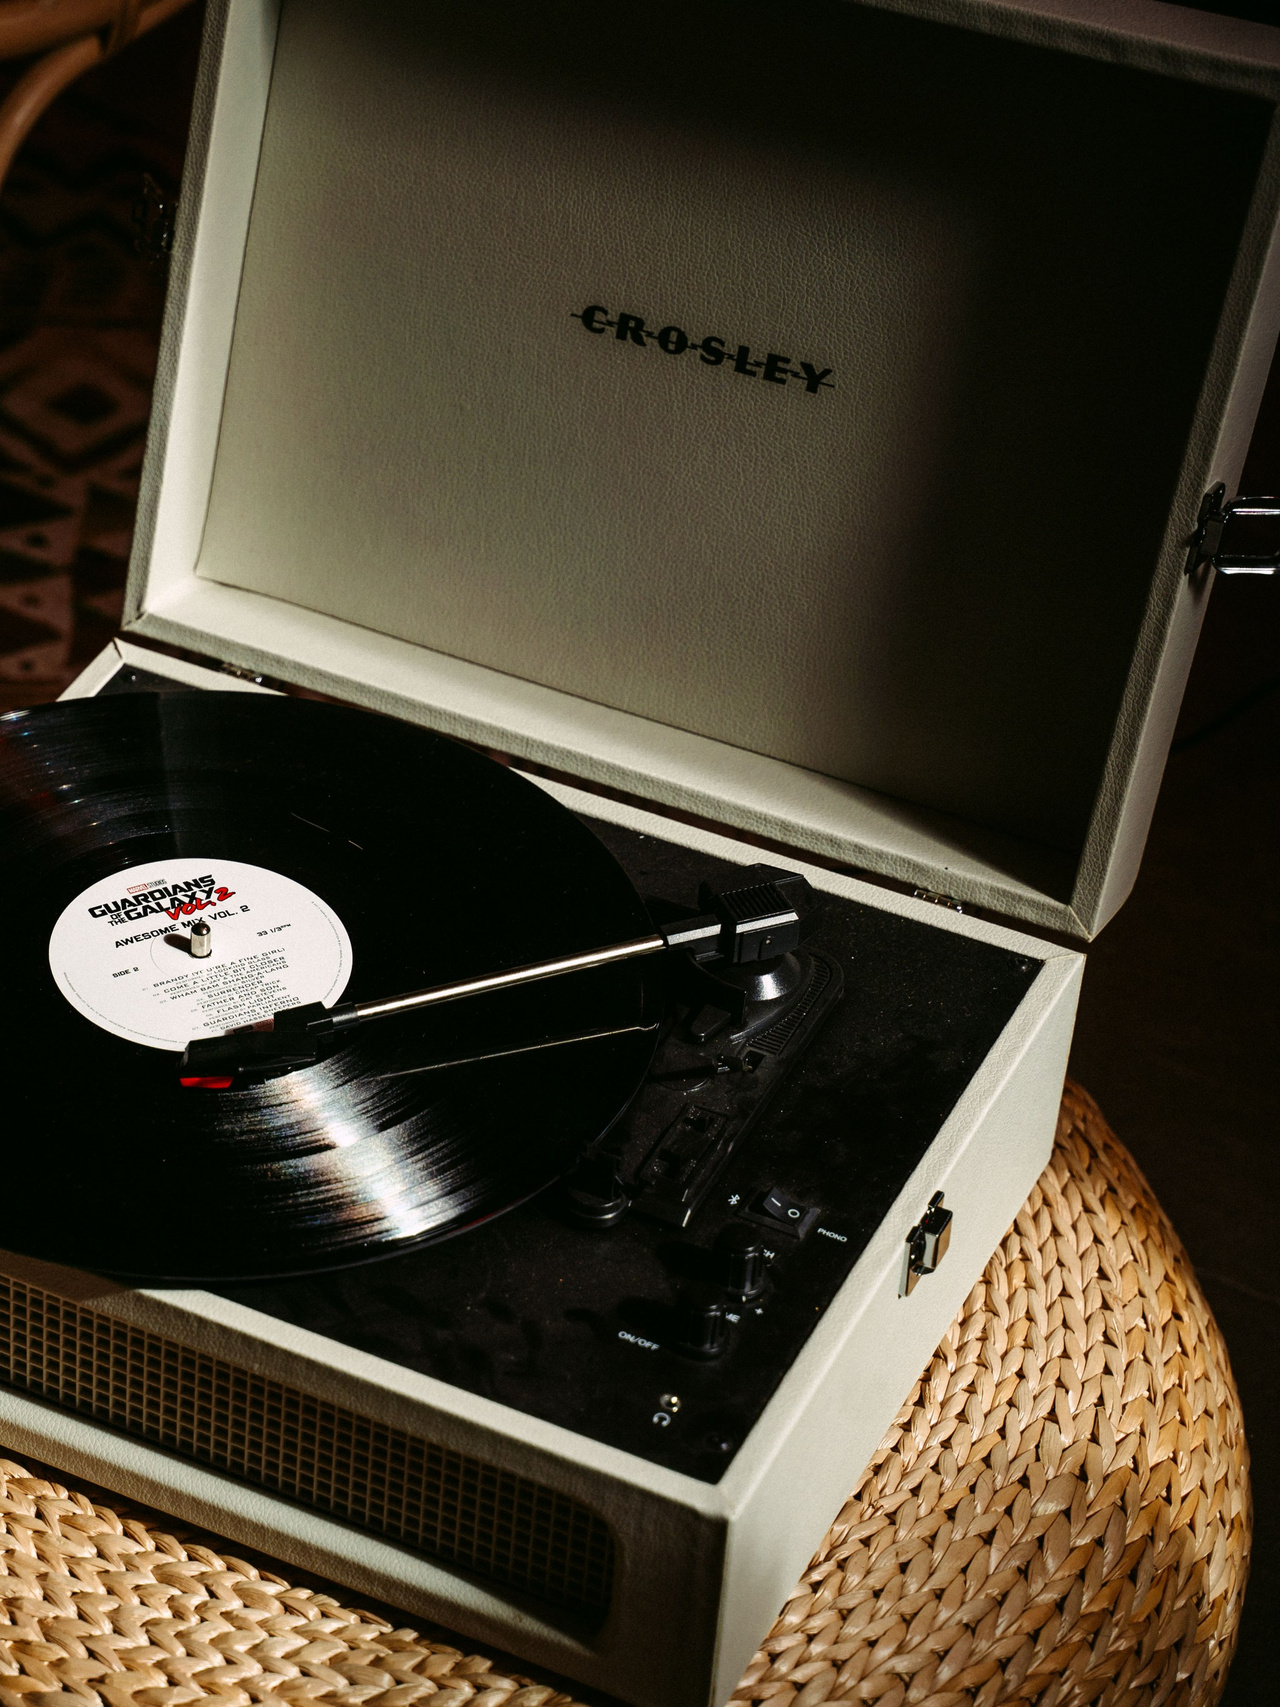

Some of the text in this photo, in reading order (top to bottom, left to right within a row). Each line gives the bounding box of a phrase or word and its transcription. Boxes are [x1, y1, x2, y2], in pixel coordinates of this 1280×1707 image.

[572, 305, 834, 394] CROSLEY
[88, 874, 216, 918] GUARDIANS
[127, 879, 167, 894] MARVEL STUDIOS
[124, 886, 215, 921] GALAXY
[165, 887, 236, 920] VOL. 2
[108, 917, 129, 927] THE
[115, 905, 250, 948] AWESOME MIX VOL. 2
[112, 969, 131, 978] SIDE
[153, 974, 189, 988] BRANDY
[238, 954, 259, 963] FINE
[261, 947, 286, 957] GIRL)
[163, 983, 190, 994] COME
[201, 972, 230, 982] LITTLE
[249, 956, 285, 970] CLOSER
[170, 989, 198, 1001] WHAM
[200, 983, 220, 992] BAM
[222, 964, 289, 986] SHANG-A-LANG
[201, 996, 235, 1009] FATHER
[238, 990, 257, 999] AND
[260, 984, 280, 993] SON
[207, 980, 263, 999] SURRENDER
[216, 1003, 246, 1014] FLASH
[248, 994, 275, 1004] LIGHT
[202, 1009, 257, 1027] GUARDIANS
[258, 996, 300, 1011] INFERNO
[817, 1227, 848, 1242] PHONO
[618, 1331, 660, 1350] ON/OFF
